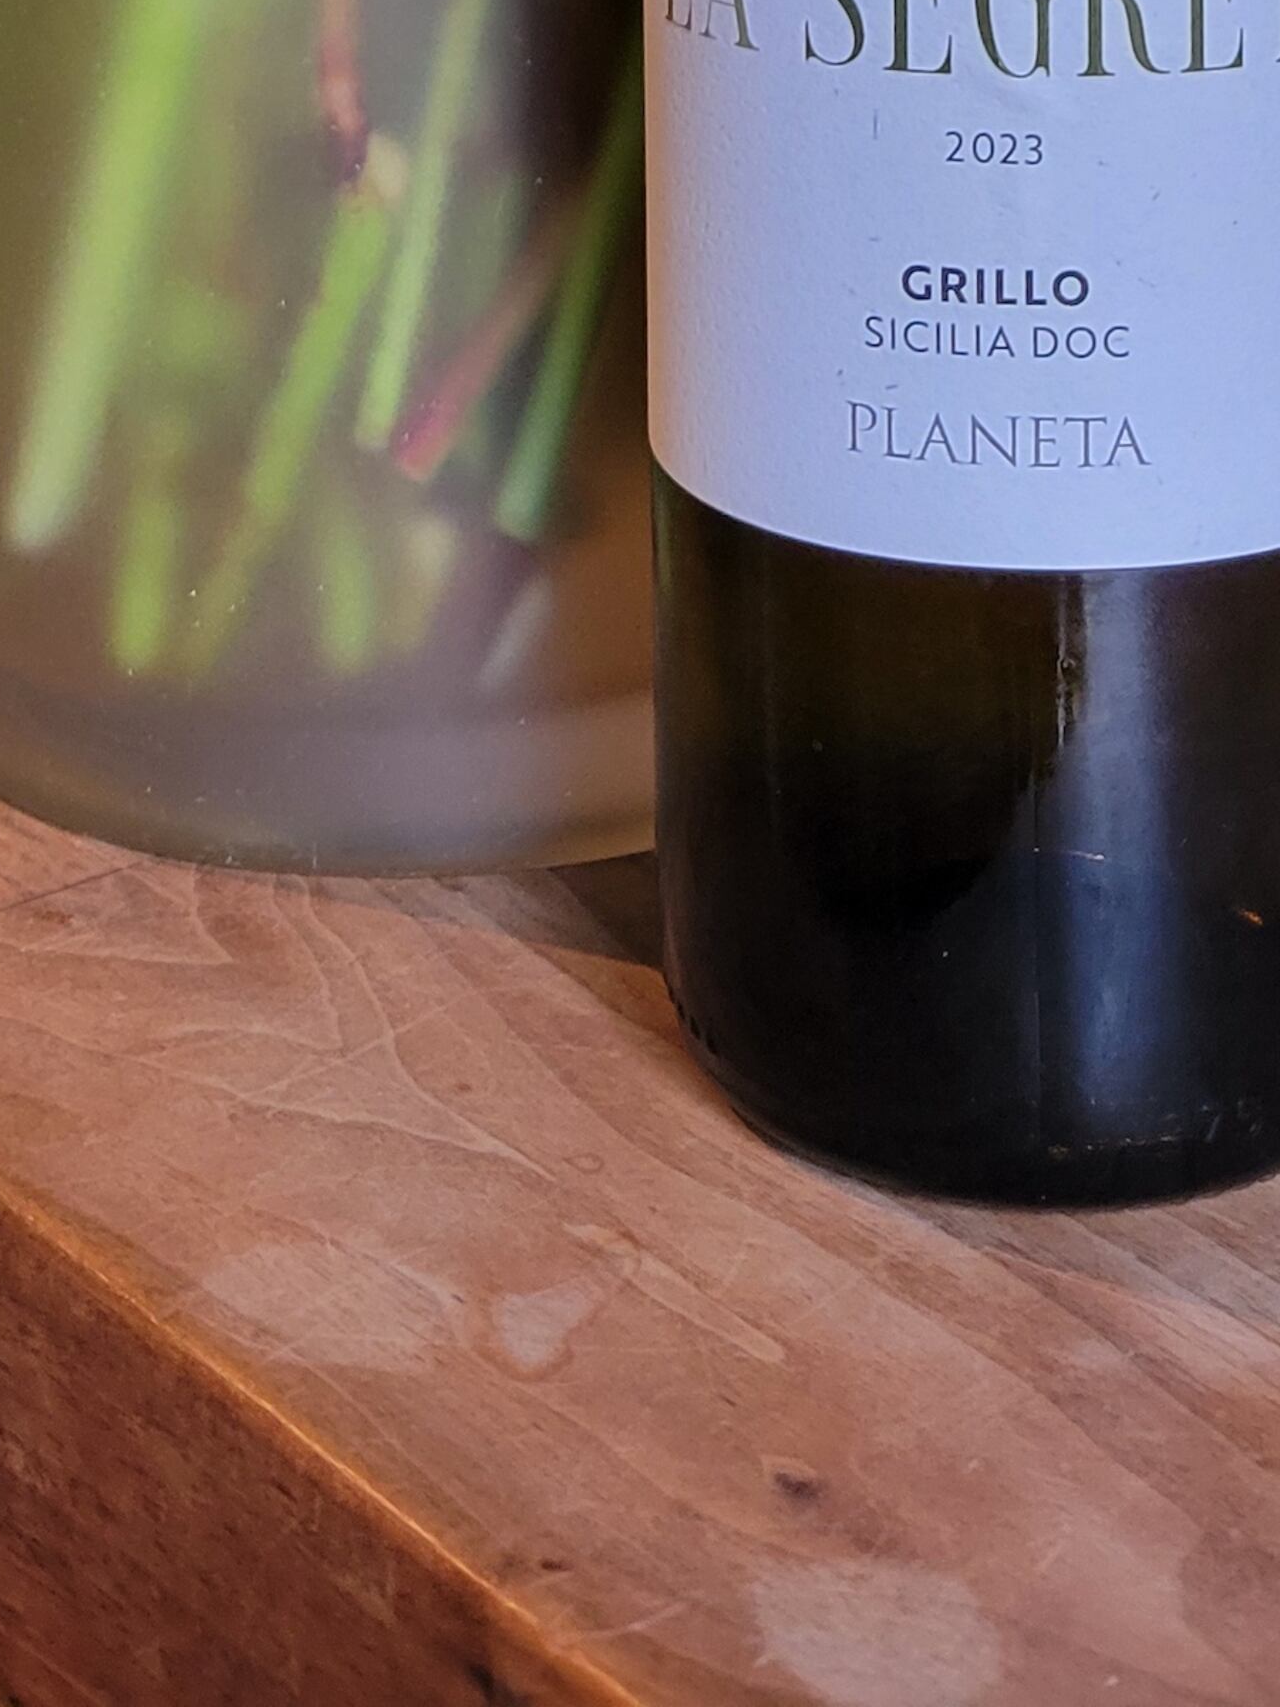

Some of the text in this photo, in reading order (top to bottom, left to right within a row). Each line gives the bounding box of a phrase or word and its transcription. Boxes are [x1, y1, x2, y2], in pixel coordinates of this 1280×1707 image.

[944, 131, 1044, 165] 2023
[901, 264, 1090, 307] GRILLO
[864, 315, 1131, 360] SICILIA DOC
[845, 400, 1153, 469] PLANETA
